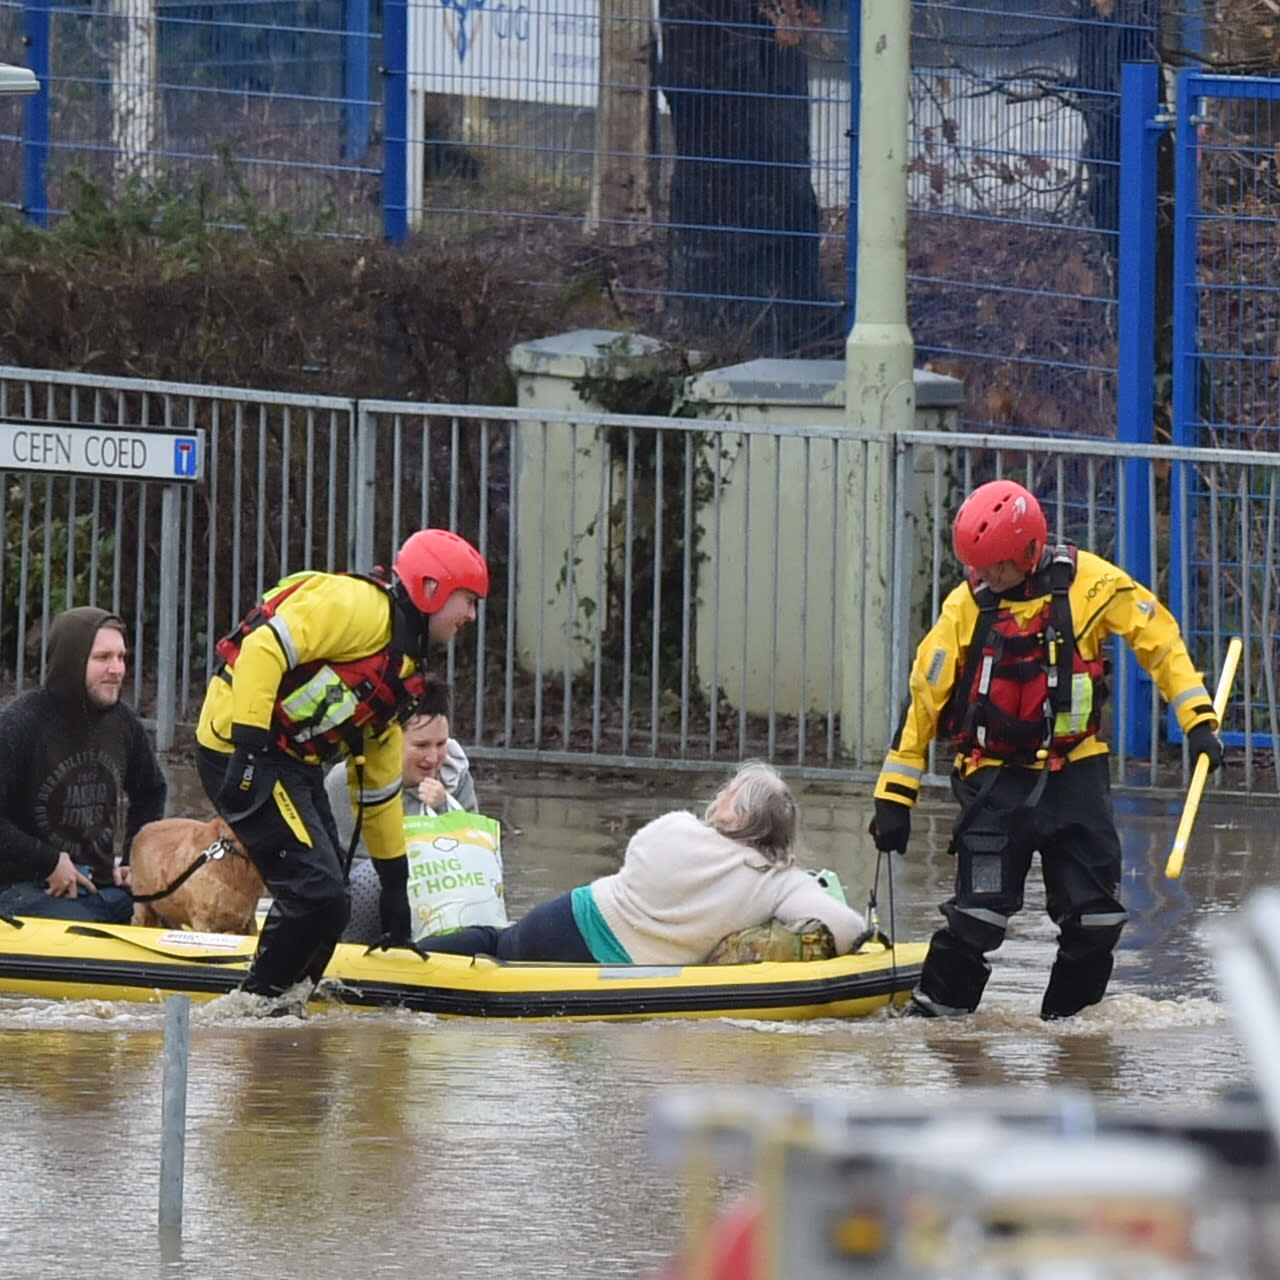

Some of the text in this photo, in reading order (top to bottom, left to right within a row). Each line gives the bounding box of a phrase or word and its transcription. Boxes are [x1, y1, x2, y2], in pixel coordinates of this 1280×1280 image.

[12, 431, 147, 469] CEFN COED
[409, 858, 462, 881] RING
[408, 871, 486, 899] T HOME
